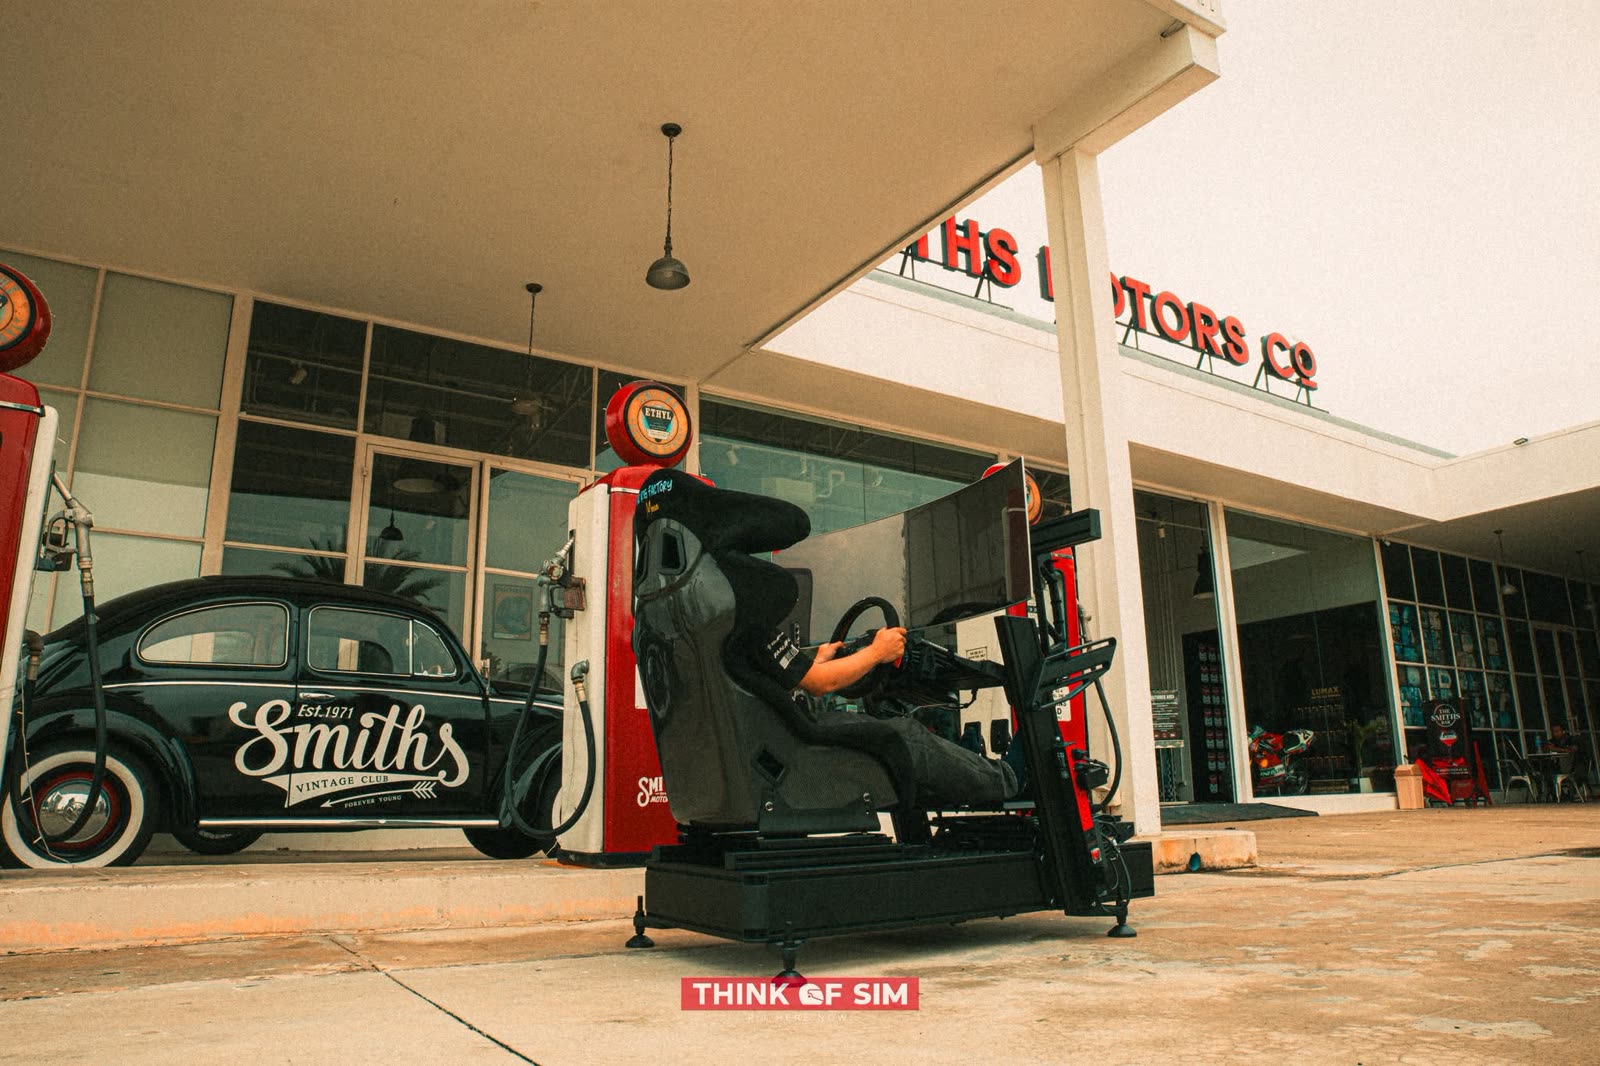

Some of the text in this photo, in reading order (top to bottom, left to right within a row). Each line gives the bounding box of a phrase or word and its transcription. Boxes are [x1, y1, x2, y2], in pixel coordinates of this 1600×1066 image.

[644, 407, 672, 420] ETHYL
[1430, 712, 1461, 721] SMITHS
[228, 699, 470, 787] Smiths
[296, 775, 389, 793] VINTAGE CLUB
[637, 776, 663, 807] SMI
[344, 794, 402, 808] FOREVER YOUNG
[650, 795, 669, 803] MOTO
